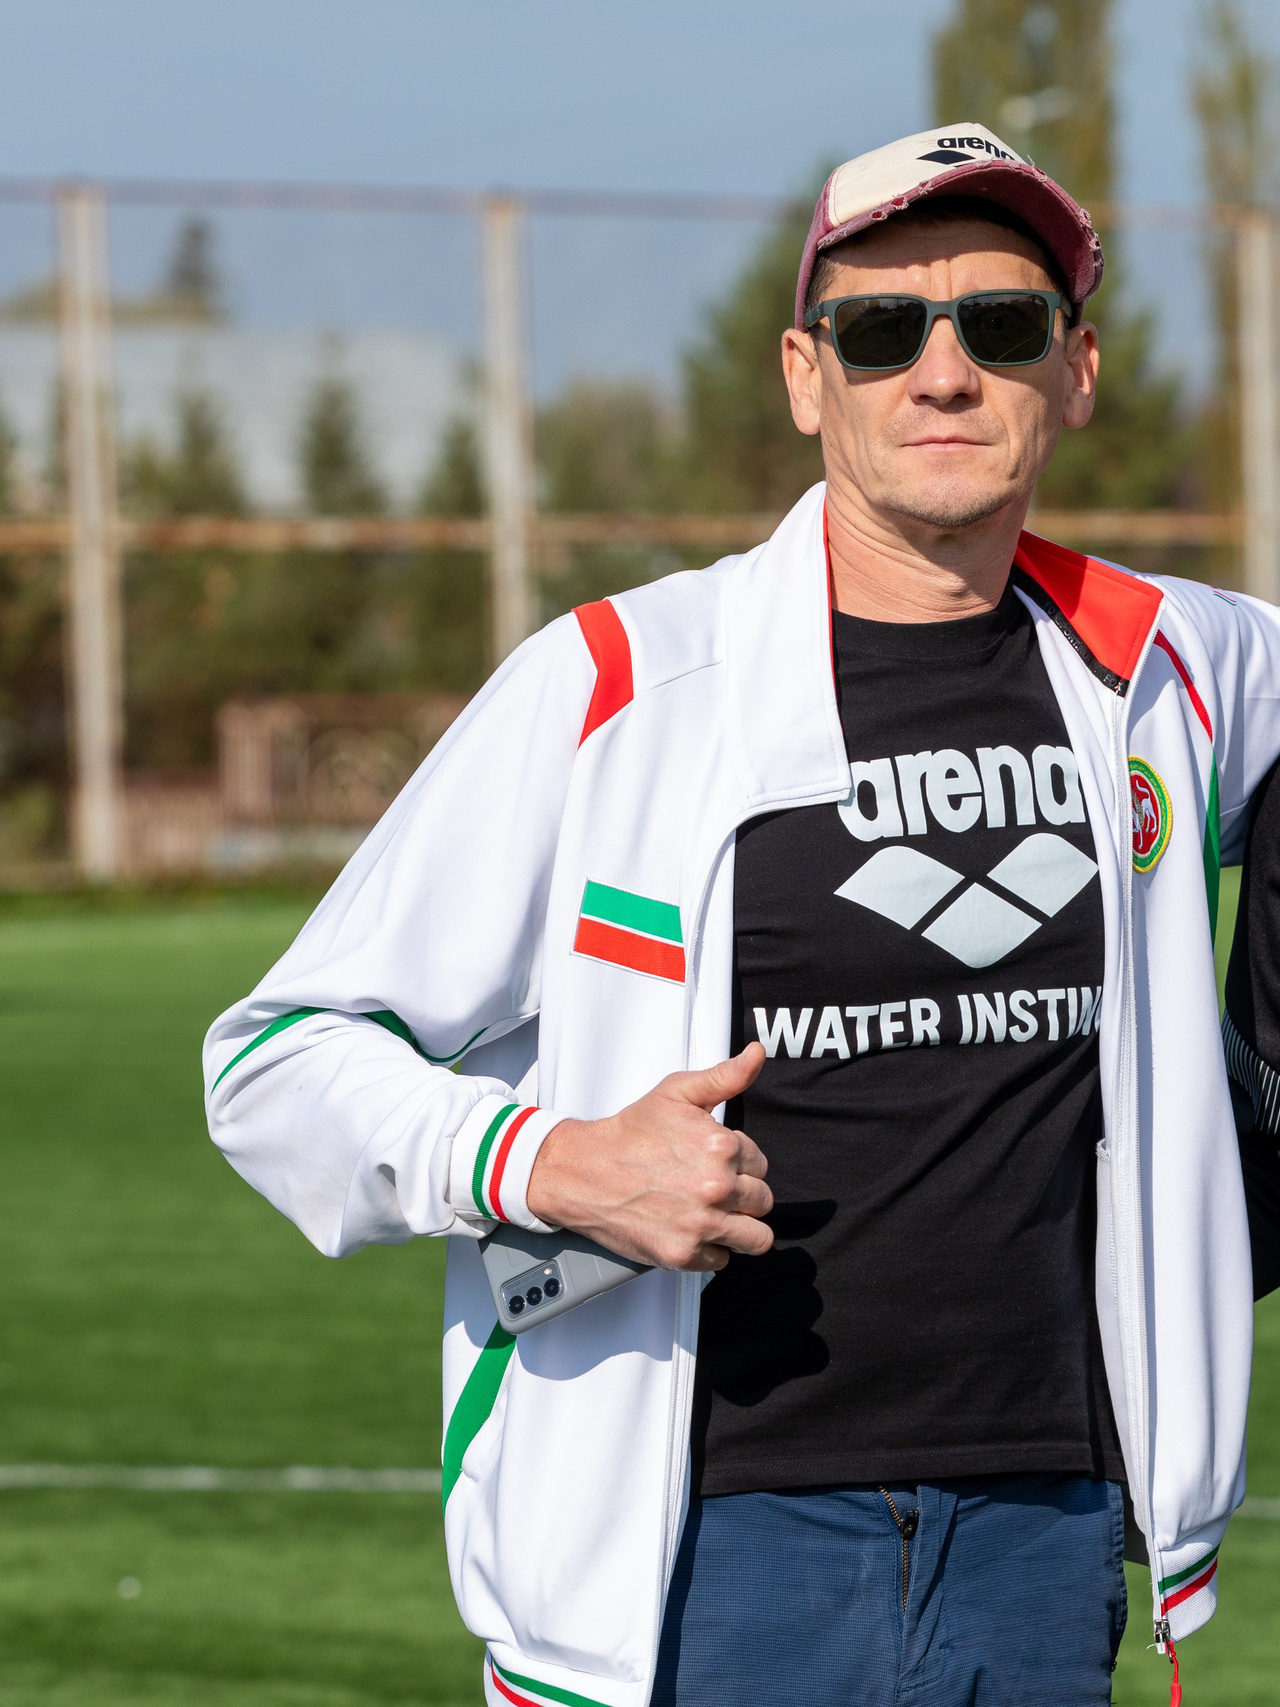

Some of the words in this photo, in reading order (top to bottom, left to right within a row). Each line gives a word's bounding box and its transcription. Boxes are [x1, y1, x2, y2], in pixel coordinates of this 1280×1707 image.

[837, 744, 1086, 842] arena
[753, 998, 940, 1059] WATER
[956, 985, 1103, 1045] INSTIN
